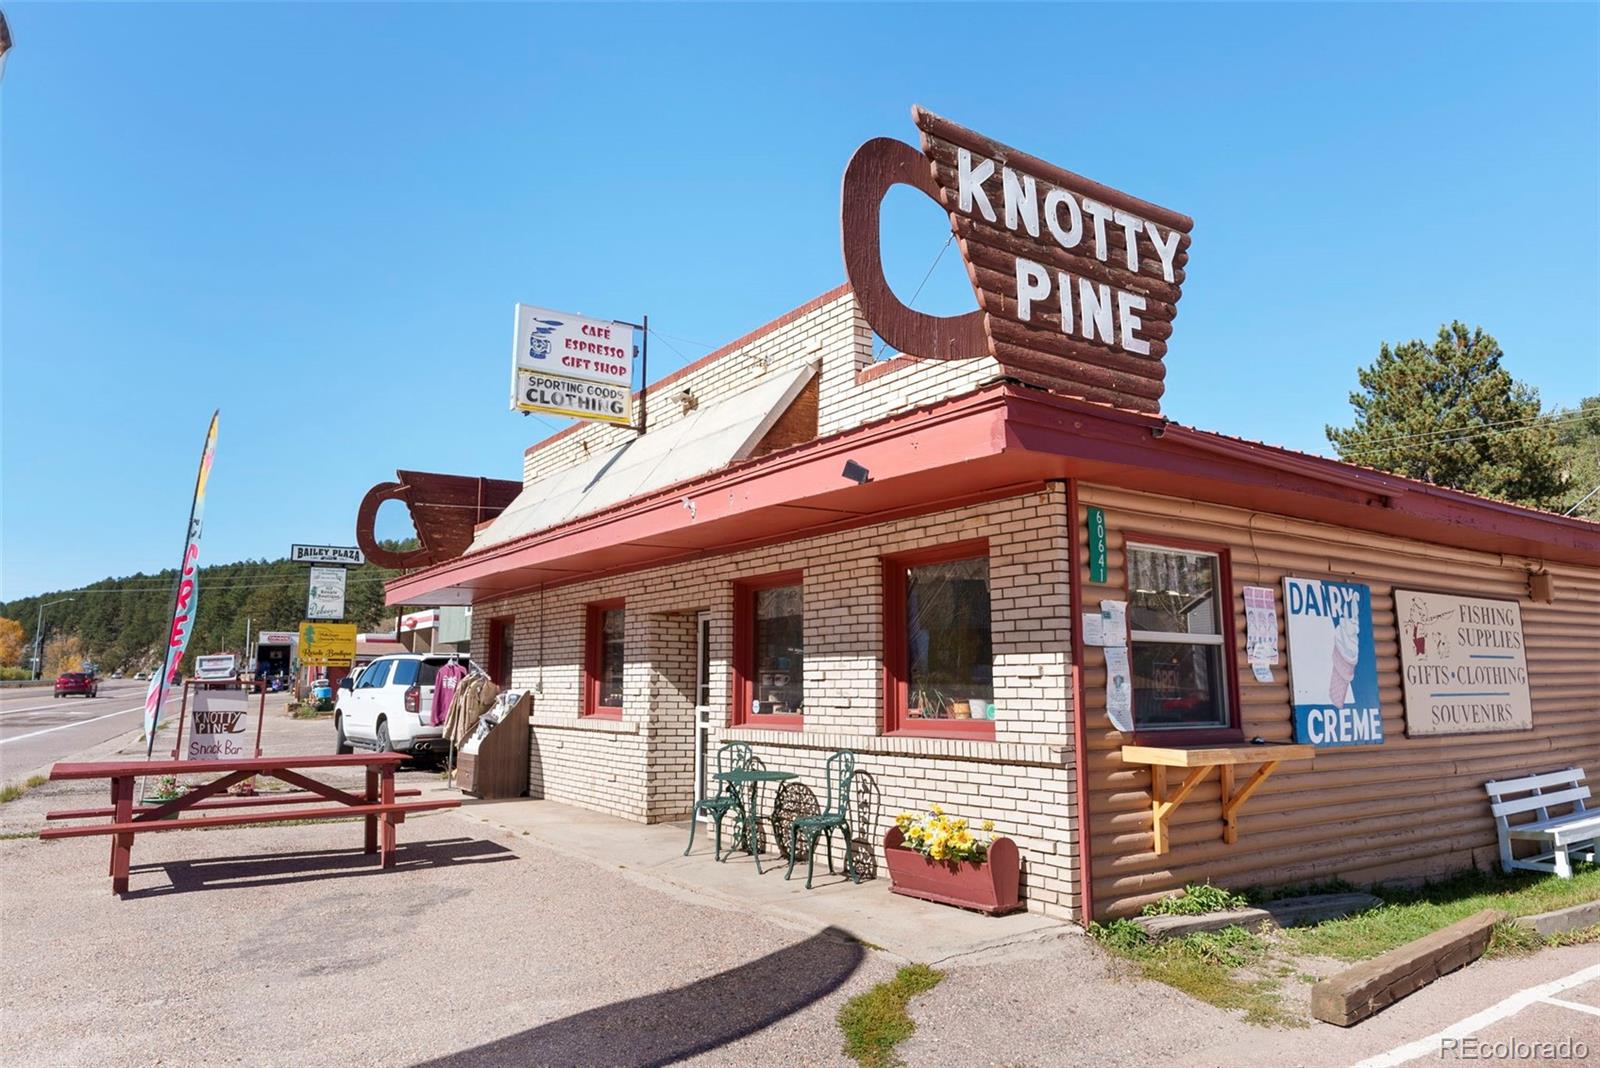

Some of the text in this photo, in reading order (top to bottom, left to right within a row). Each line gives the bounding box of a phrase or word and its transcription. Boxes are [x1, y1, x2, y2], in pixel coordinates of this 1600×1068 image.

[958, 148, 1181, 283] KNOTTY
[1015, 257, 1150, 355] PINE
[581, 325, 611, 339] CAFÉ
[565, 338, 625, 358] ESPRESSO
[562, 356, 627, 376] GIFT SHOP
[528, 376, 624, 400] SPORTING GOODS
[526, 388, 624, 414] CLOTHING
[297, 547, 360, 562] BAILEY PLAZA
[1095, 511, 1105, 583] 60641
[1289, 582, 1355, 619] DAIRY
[1459, 604, 1514, 627] FISHING
[1457, 627, 1521, 649] SUPPLIES
[1407, 664, 1526, 685] GIFTS CLOTHING
[194, 711, 241, 724] KNOTTY
[1431, 703, 1513, 725] SOUVENIRS
[200, 724, 229, 734] PINE
[1307, 708, 1382, 744] CREME
[190, 739, 242, 756] Snack Bar
